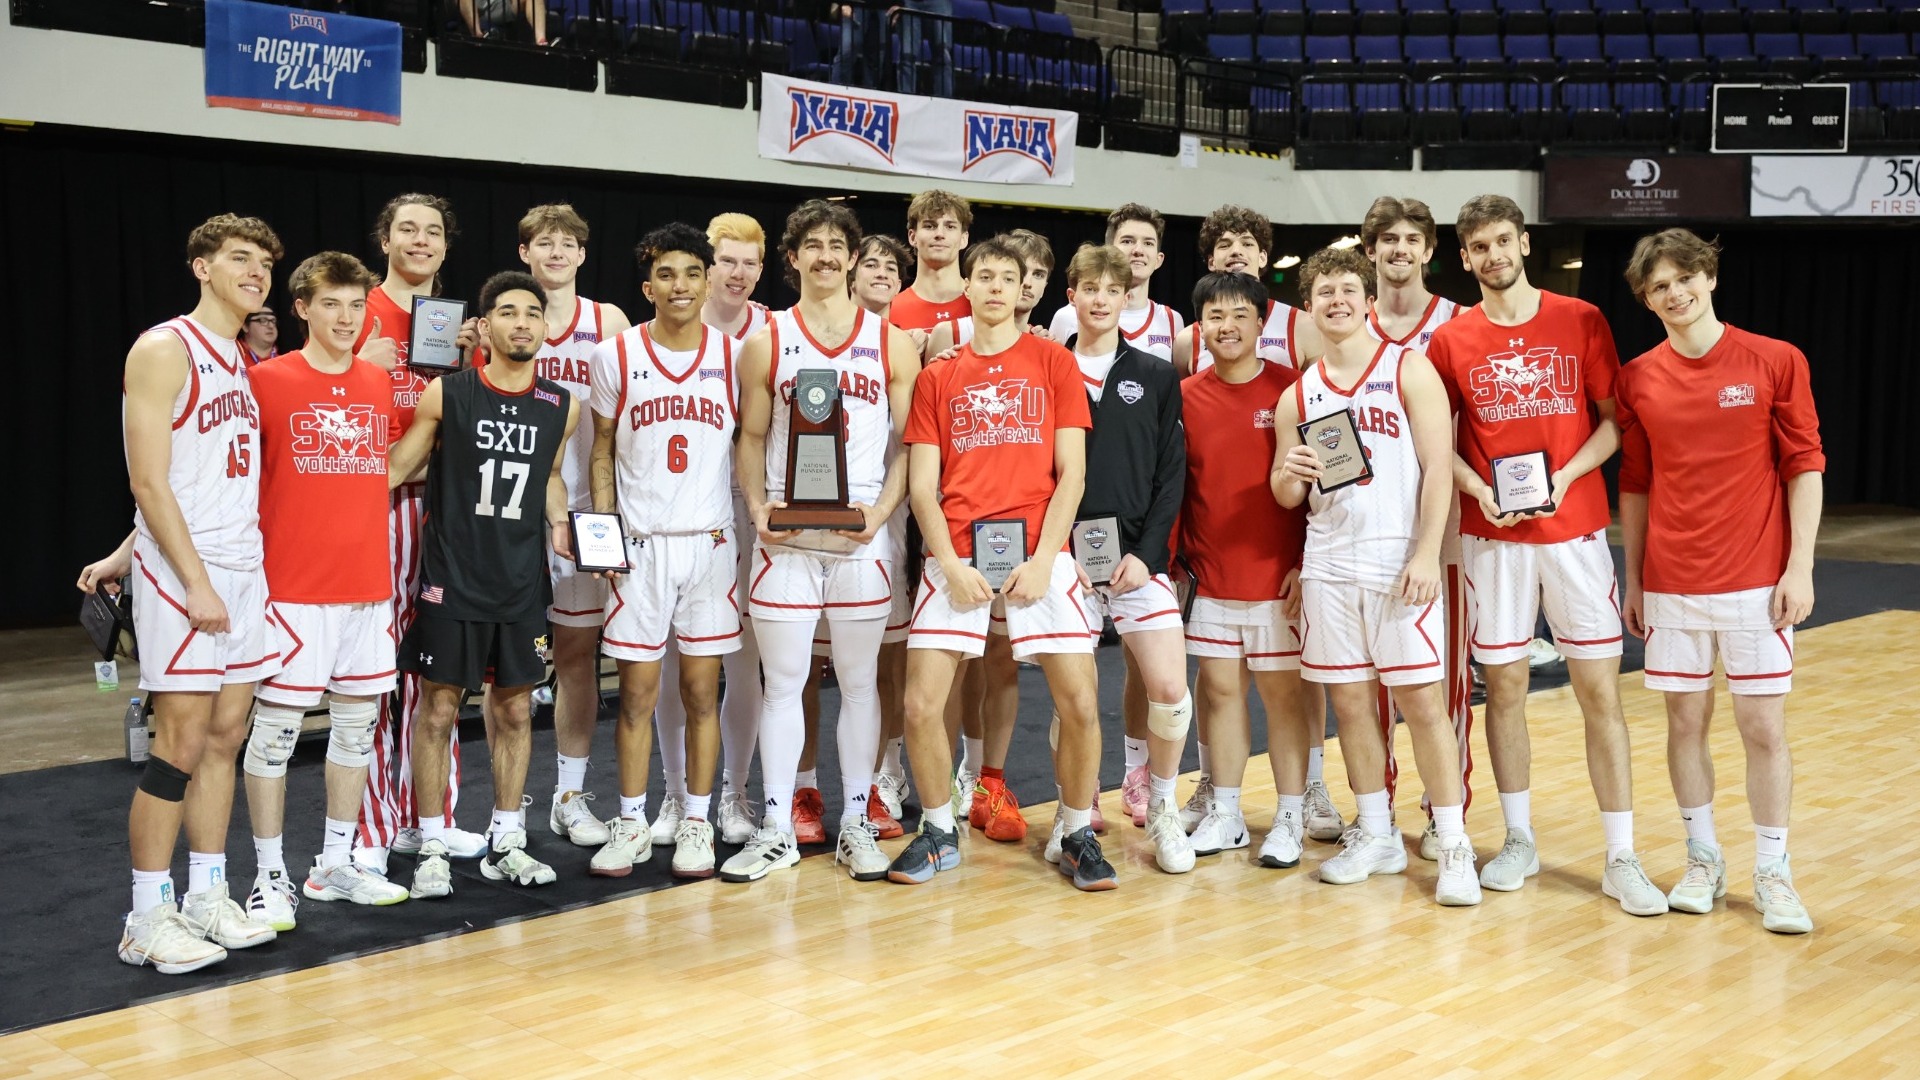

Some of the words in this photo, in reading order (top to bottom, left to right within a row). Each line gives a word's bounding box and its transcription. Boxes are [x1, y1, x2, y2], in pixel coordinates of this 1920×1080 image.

[290, 14, 327, 32] NAIA
[238, 43, 252, 53] THE
[254, 36, 319, 68] RIGHT
[323, 44, 365, 73] WAY
[364, 58, 372, 68] TO
[274, 64, 338, 100] PLAY
[790, 91, 894, 156] NAIA
[1723, 115, 1748, 125] HOME
[1812, 115, 1840, 125] GUEST
[965, 113, 1054, 168] NAIA
[1871, 200, 1920, 214] FIRS
[574, 332, 598, 343] NAIA
[1261, 337, 1285, 347] NAIA
[851, 347, 879, 360] NAIA
[699, 369, 725, 381] NAIA
[534, 388, 560, 405] NAIA
[1366, 382, 1393, 392] NAIA
[630, 395, 725, 432] COUGARS
[1476, 398, 1577, 424] VOLLEYBALL
[476, 419, 538, 455] SXU
[951, 427, 1043, 454] VOLLEYBALL
[226, 434, 251, 478] 15
[667, 434, 689, 474] 6
[1325, 453, 1348, 464] NATIONAL
[293, 456, 387, 475] VOLLEYBALL
[475, 458, 531, 520] 17
